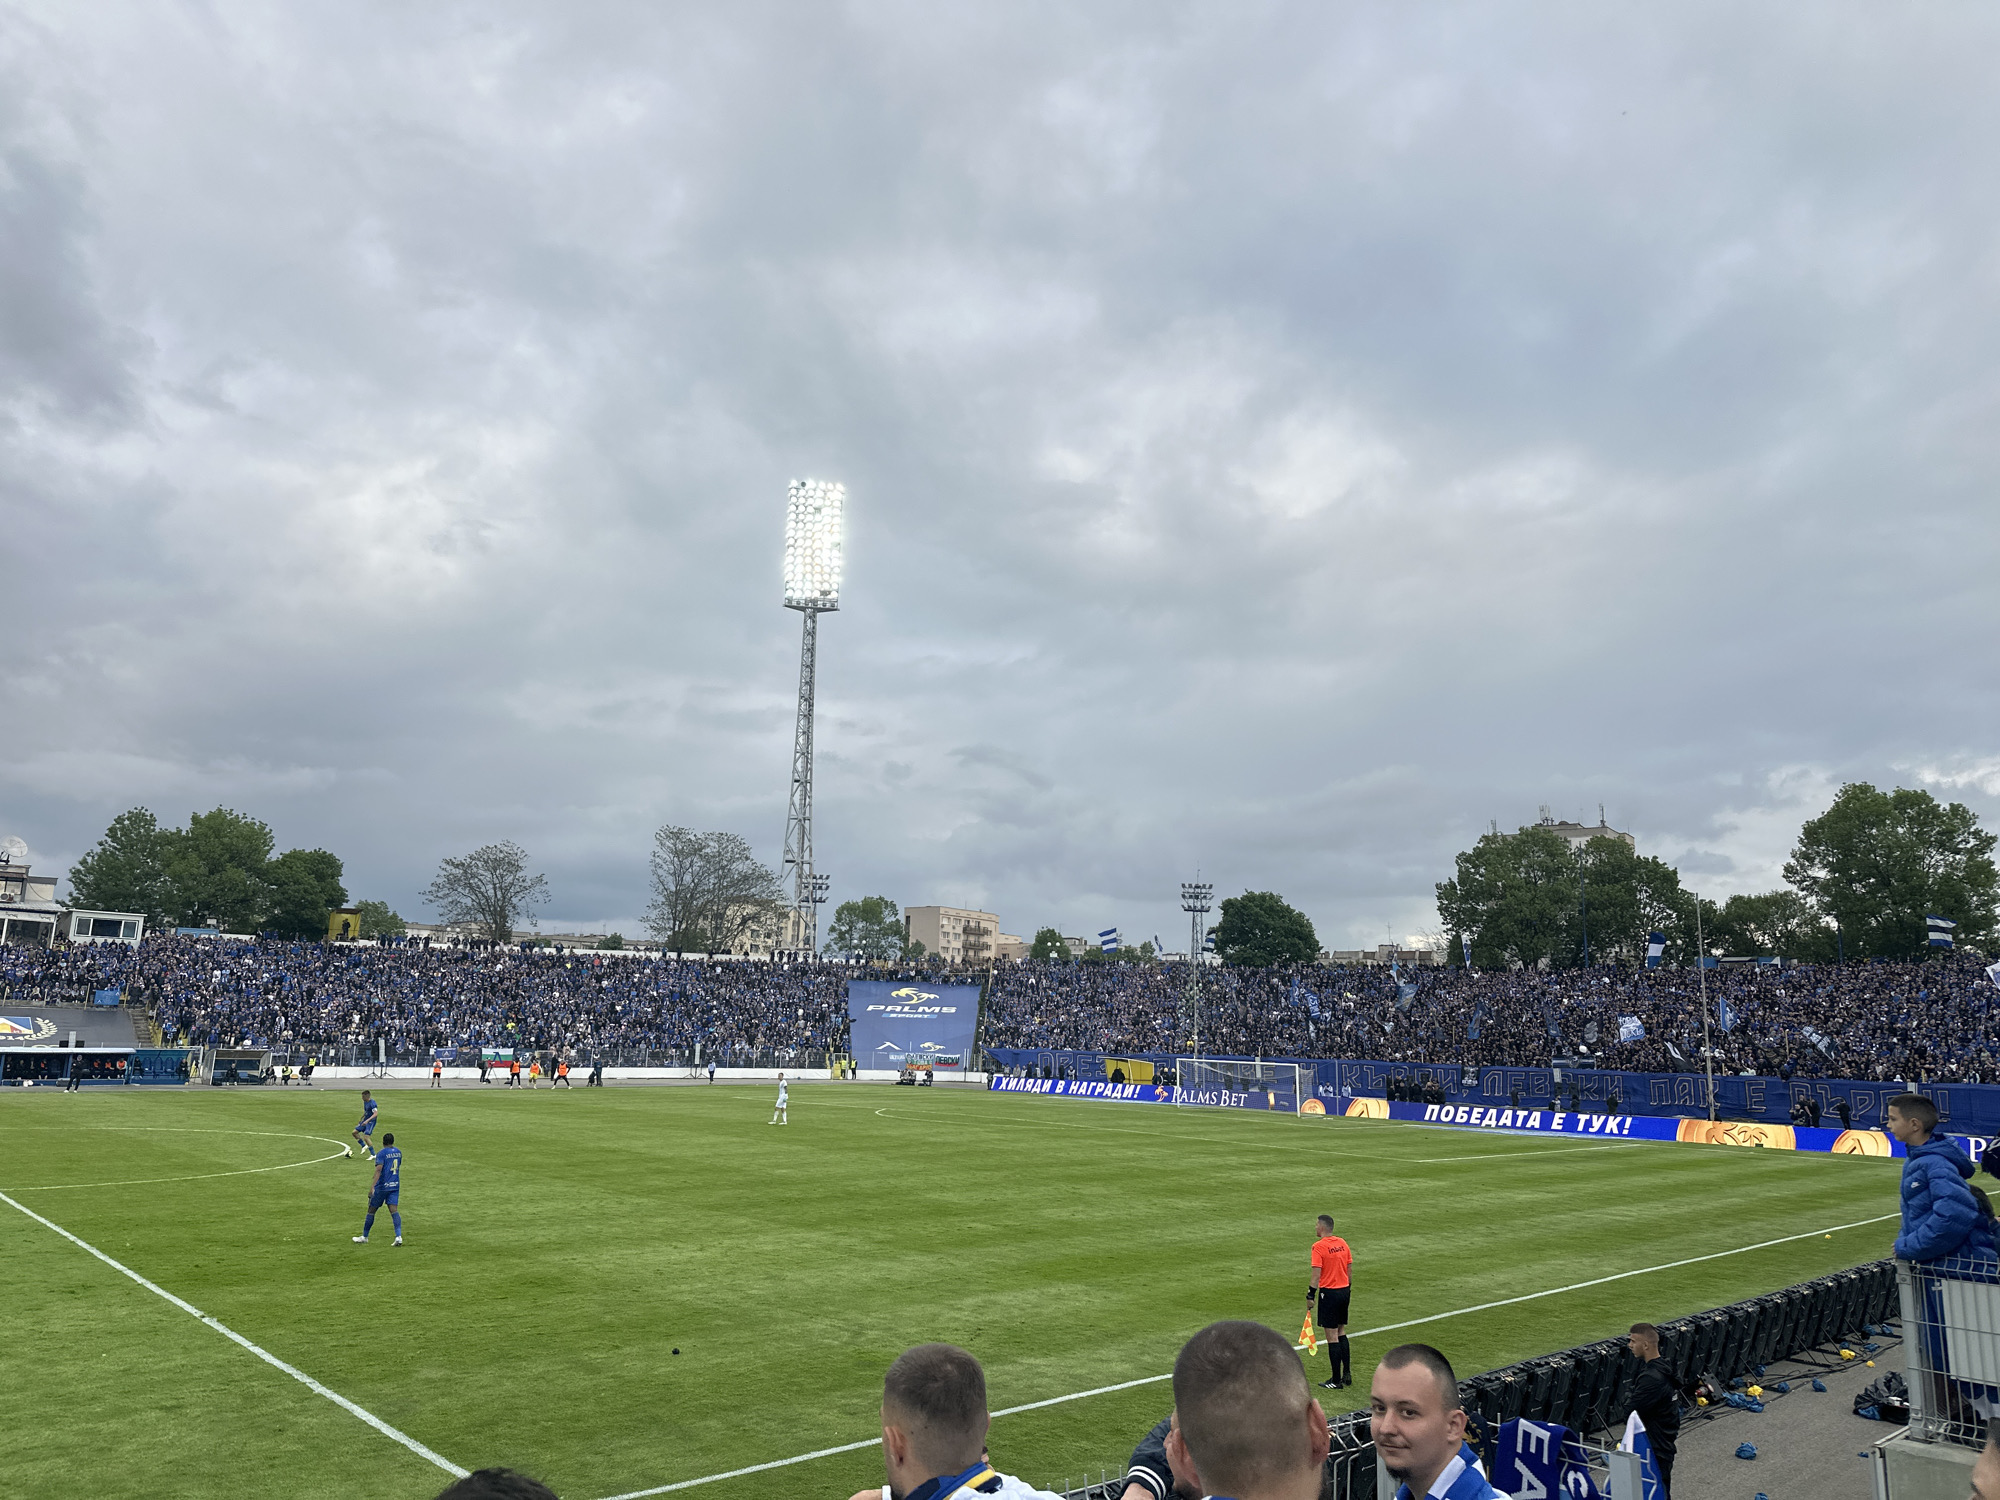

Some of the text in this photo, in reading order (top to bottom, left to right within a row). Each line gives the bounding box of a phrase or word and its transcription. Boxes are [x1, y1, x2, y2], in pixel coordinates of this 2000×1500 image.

[866, 1004, 957, 1013] PALMS
[999, 1077, 1051, 1094] ХИЛЯДИ
[1055, 1081, 1066, 1094] В
[1072, 1082, 1141, 1099] НАГРАДИ!
[1171, 1086, 1248, 1107] PALMS BET
[1424, 1104, 1633, 1135] ПОБЕДАТА Е ТУК!
[390, 1159, 398, 1175] 4
